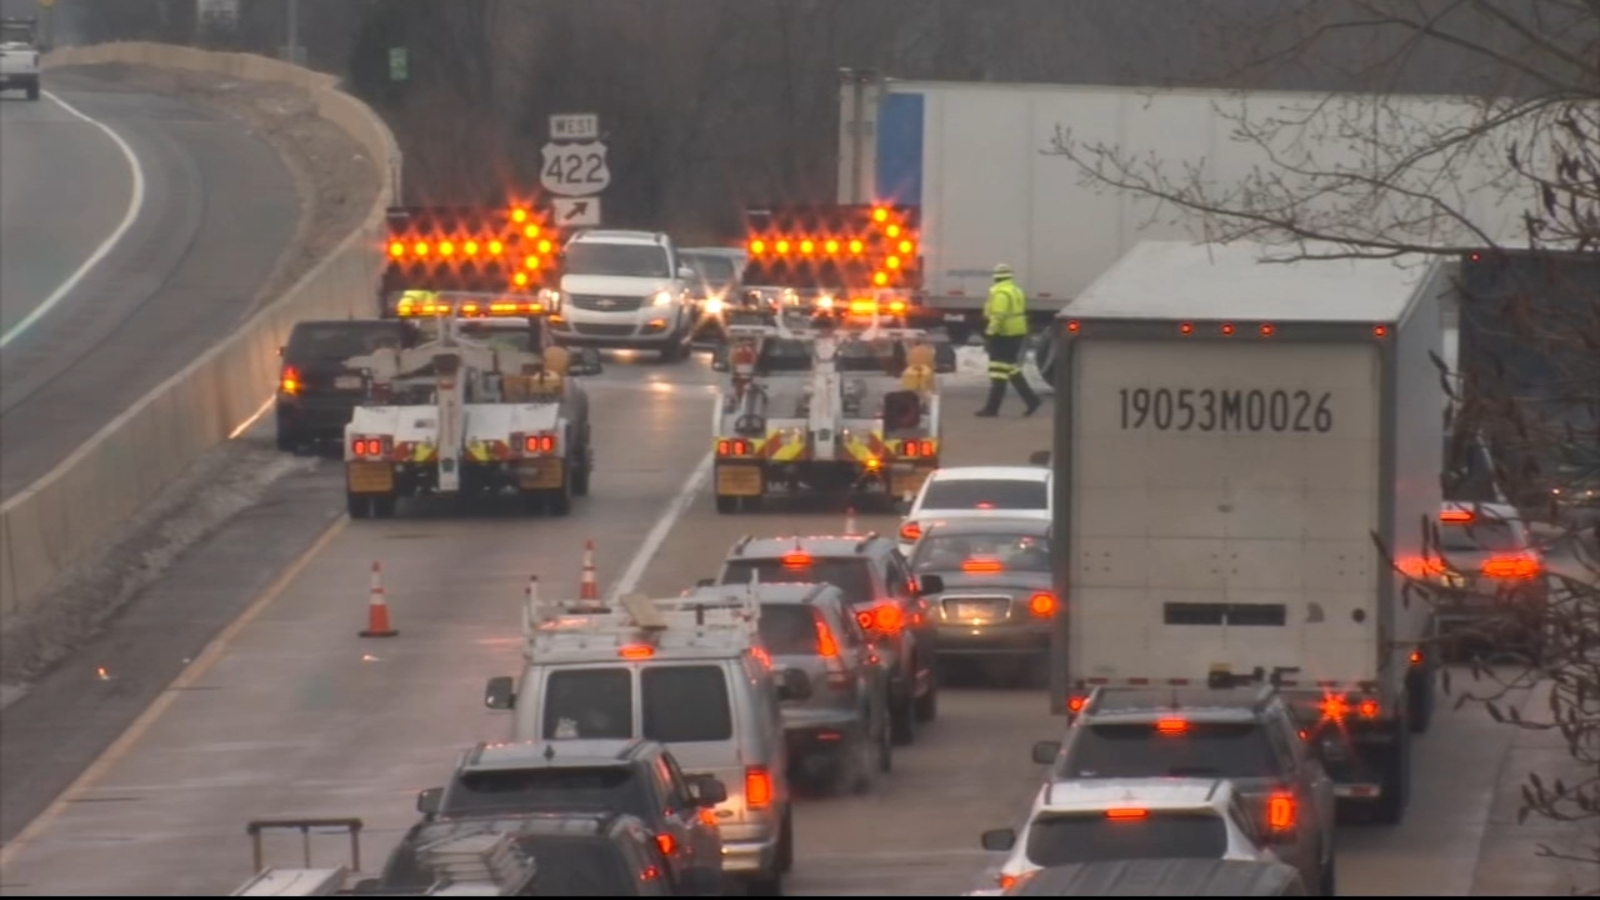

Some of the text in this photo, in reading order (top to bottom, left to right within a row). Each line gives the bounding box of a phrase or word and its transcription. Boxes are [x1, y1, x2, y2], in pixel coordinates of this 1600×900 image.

[555, 118, 594, 134] WEST
[545, 153, 605, 184] 422
[1119, 388, 1333, 433] 19053M0026
